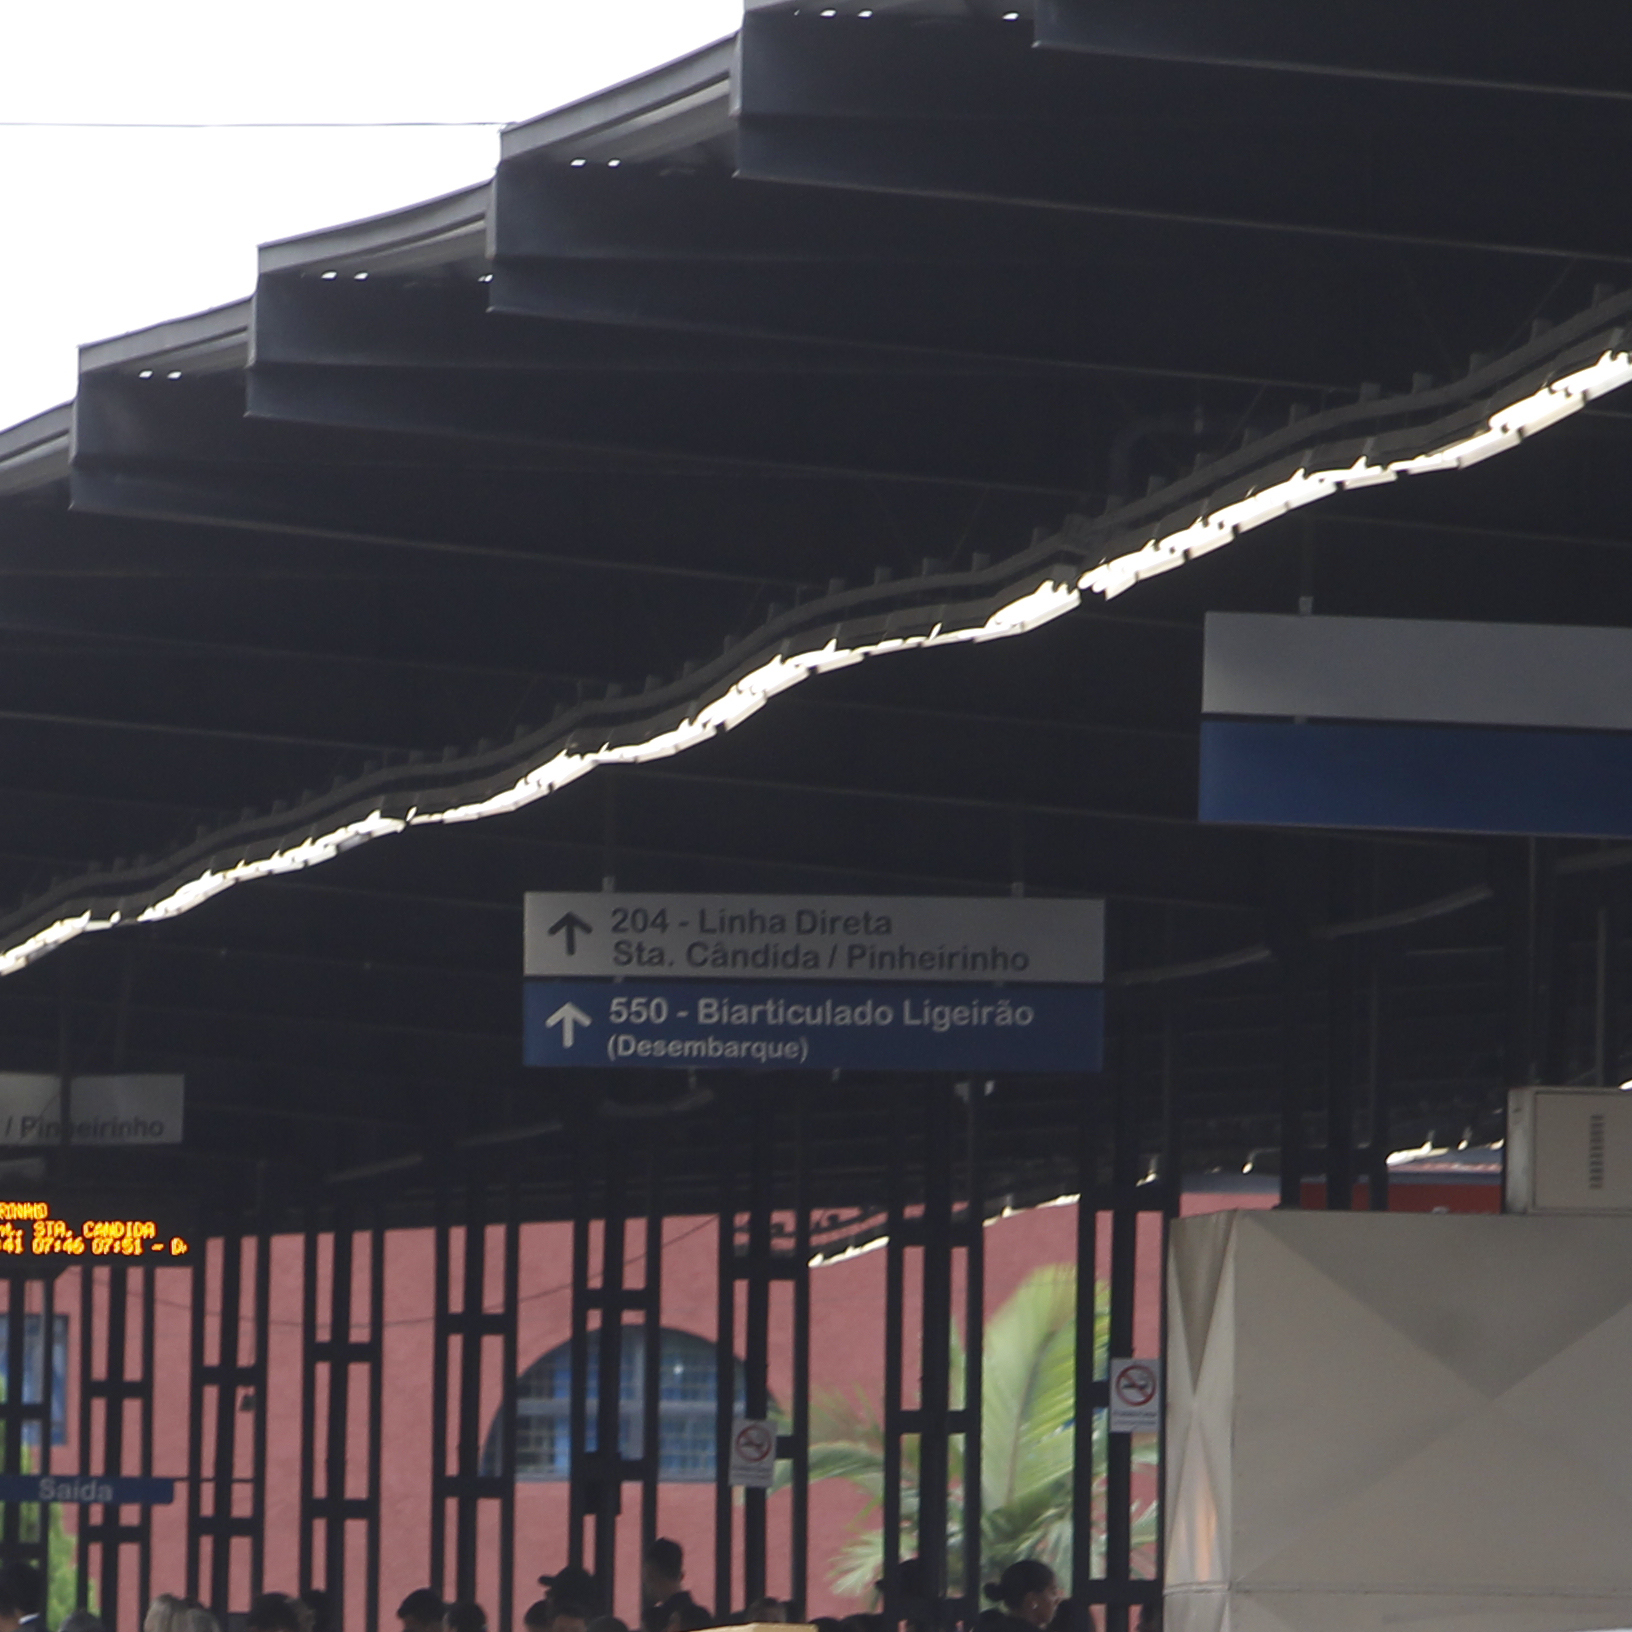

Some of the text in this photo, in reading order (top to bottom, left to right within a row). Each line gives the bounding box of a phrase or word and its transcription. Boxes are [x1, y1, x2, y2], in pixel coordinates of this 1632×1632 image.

[611, 907, 669, 934] 204
[699, 908, 787, 934] Linha
[796, 909, 892, 936] Direta
[613, 940, 674, 967] Sta.
[686, 941, 820, 970] Cândida
[847, 944, 1030, 972] Pinheirinho
[610, 997, 668, 1024] 550
[698, 998, 893, 1025] Biarticulado
[903, 999, 1034, 1032] Ligeirão
[607, 1034, 808, 1063] (Desembarque)
[20, 1114, 166, 1139] Pineirinho
